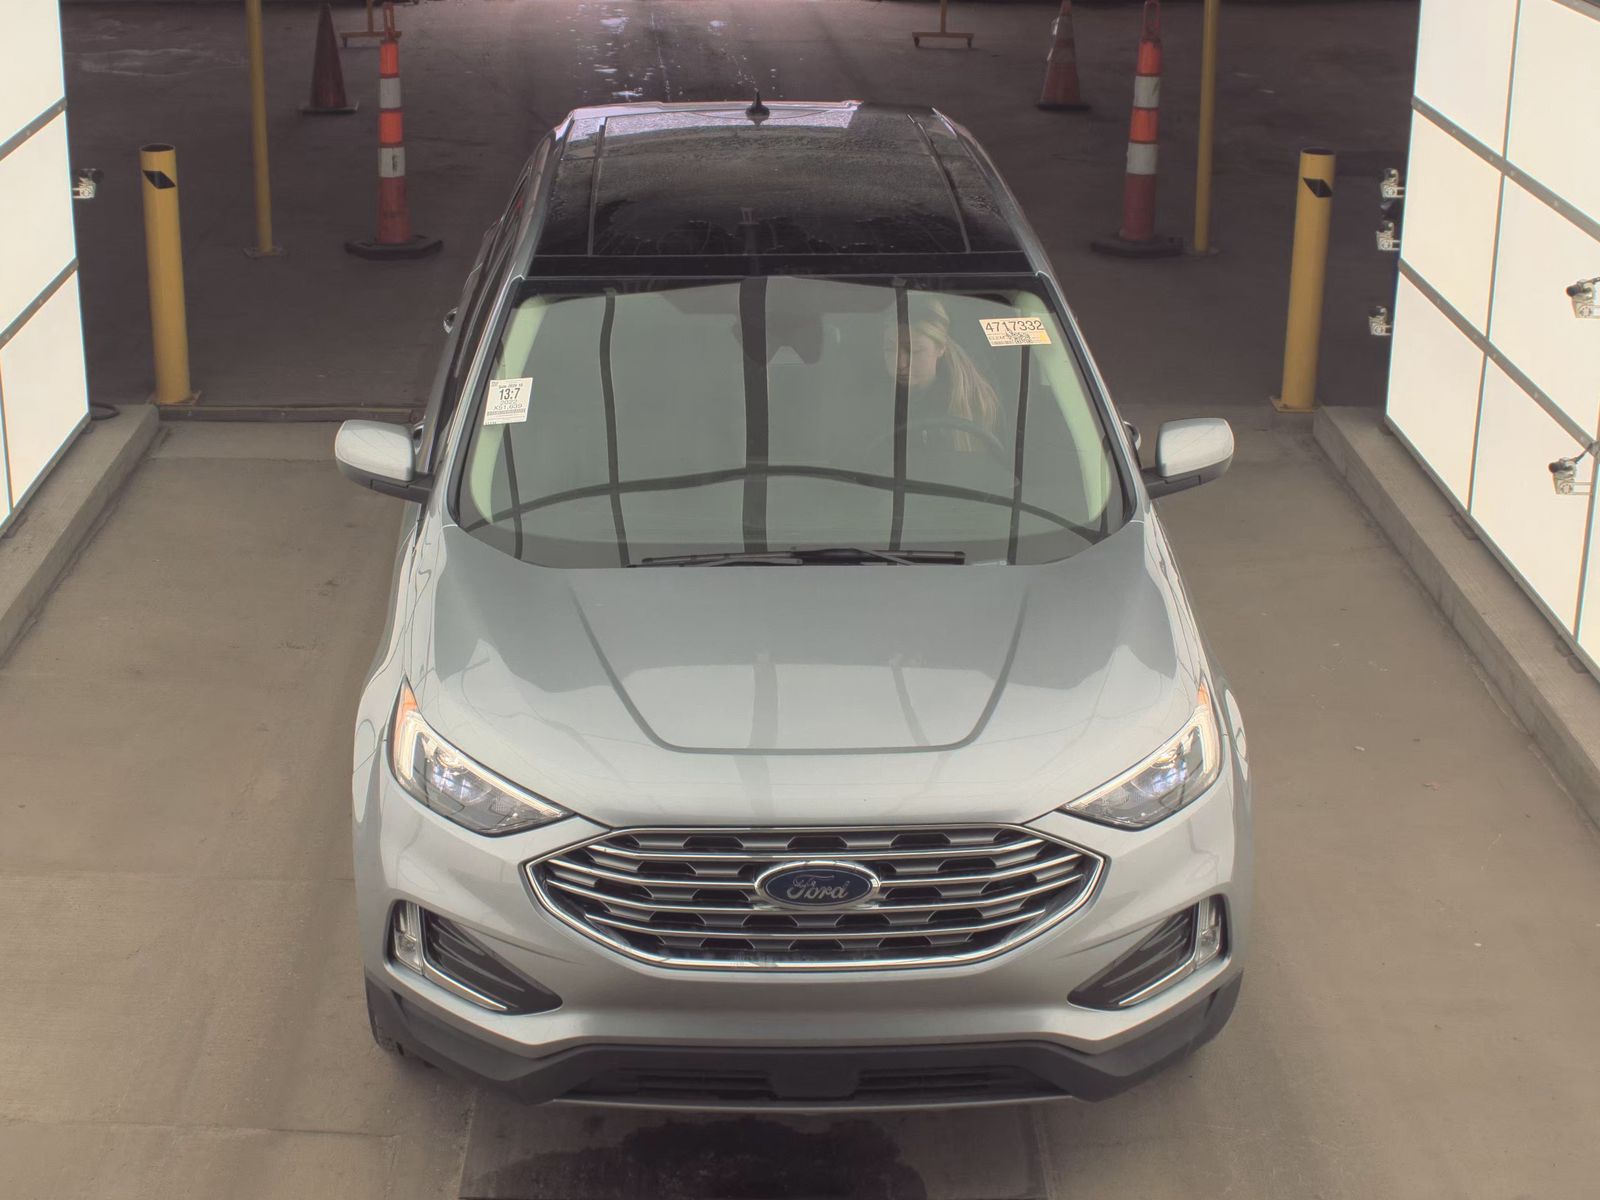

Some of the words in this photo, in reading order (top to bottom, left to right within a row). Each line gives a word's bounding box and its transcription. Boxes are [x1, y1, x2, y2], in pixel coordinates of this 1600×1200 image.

[985, 320, 1044, 332] 4717332
[499, 388, 521, 400] 13:7
[786, 874, 850, 899] Ford
